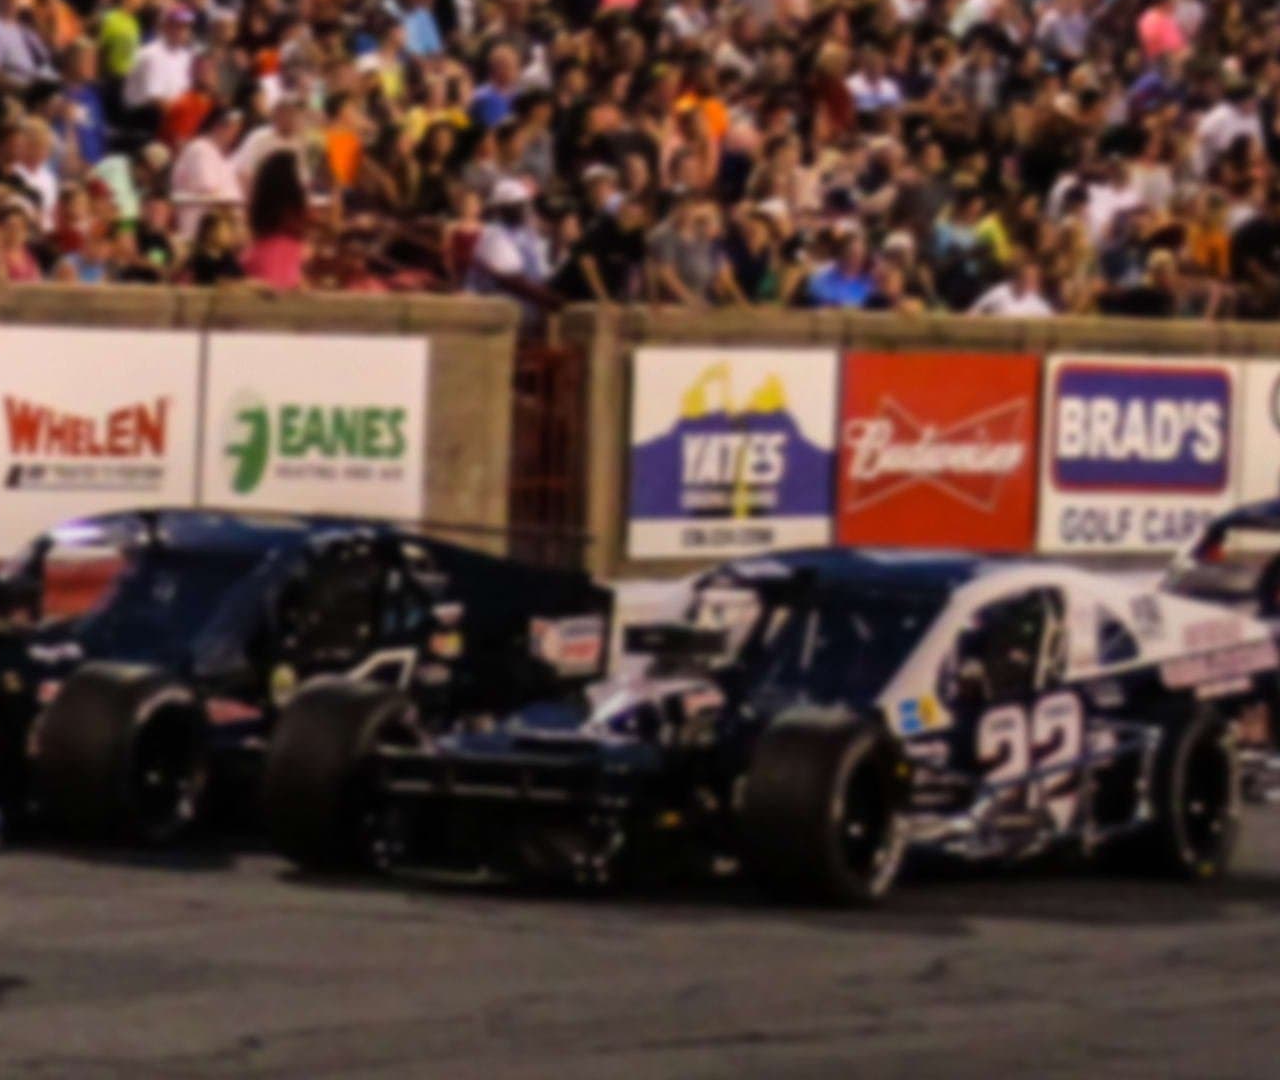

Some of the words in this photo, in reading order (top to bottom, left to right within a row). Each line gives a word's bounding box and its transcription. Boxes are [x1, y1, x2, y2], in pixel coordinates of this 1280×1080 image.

[2, 394, 171, 458] WHELEN
[277, 405, 407, 459] EANES
[843, 418, 1026, 482] Budweiser
[1057, 396, 1224, 463] BRAD'S
[682, 433, 787, 485] YATES
[1060, 506, 1132, 544] GOLF
